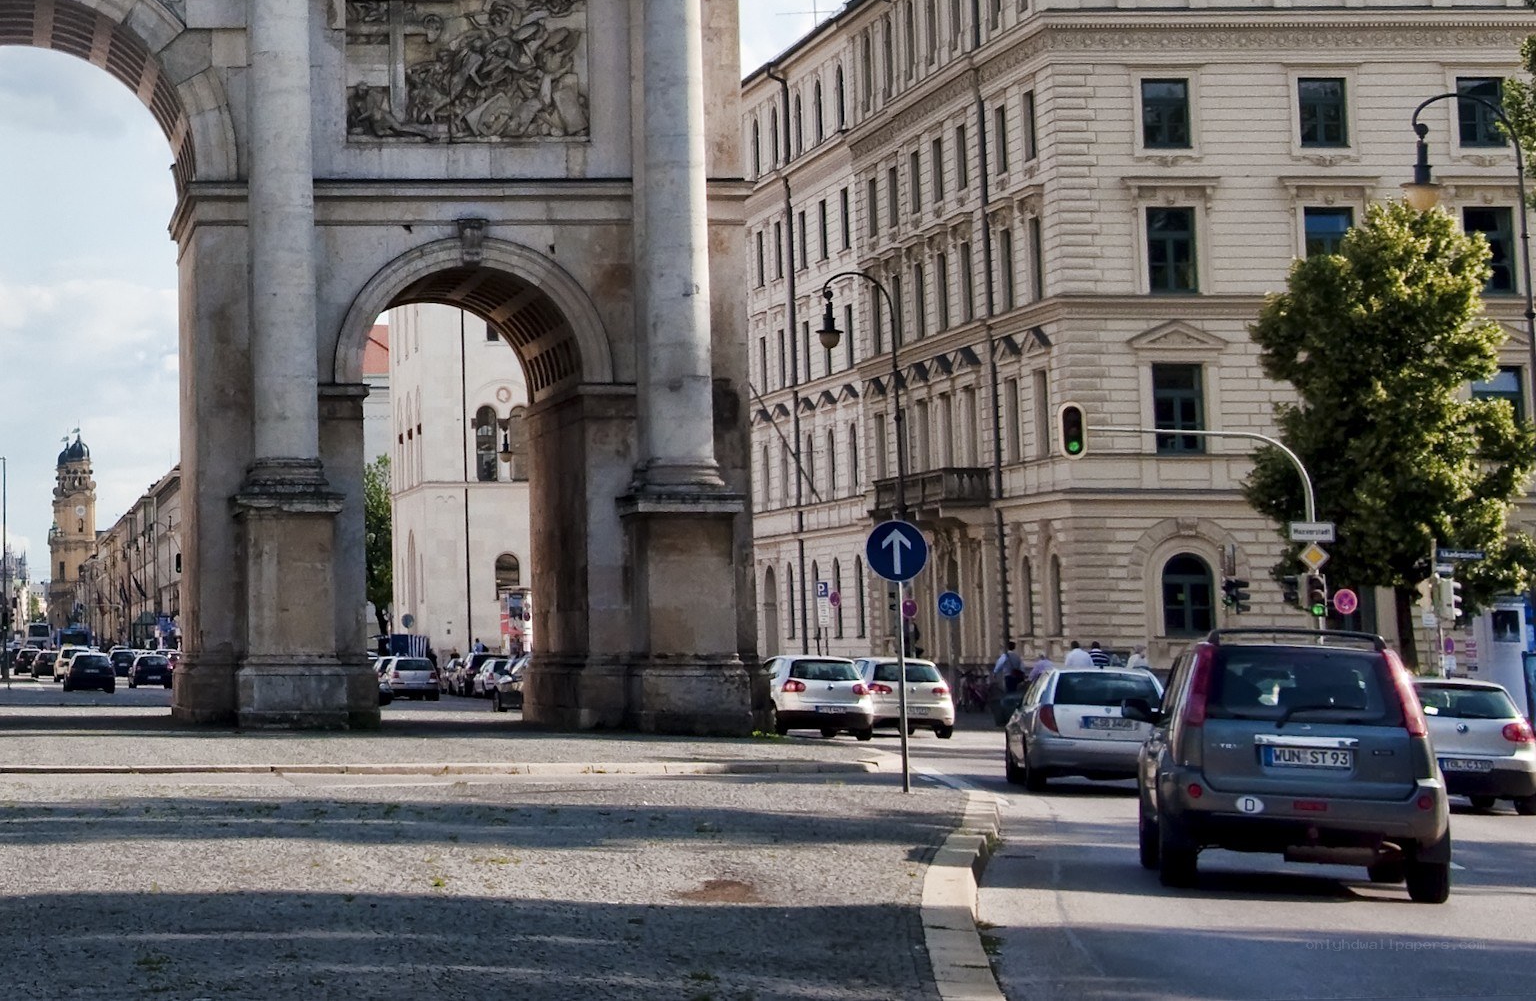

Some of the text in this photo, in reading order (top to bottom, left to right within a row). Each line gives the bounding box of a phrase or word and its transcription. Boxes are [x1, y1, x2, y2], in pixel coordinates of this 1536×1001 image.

[1274, 751, 1349, 765] WUN ST 93
[1244, 798, 1255, 812] D
